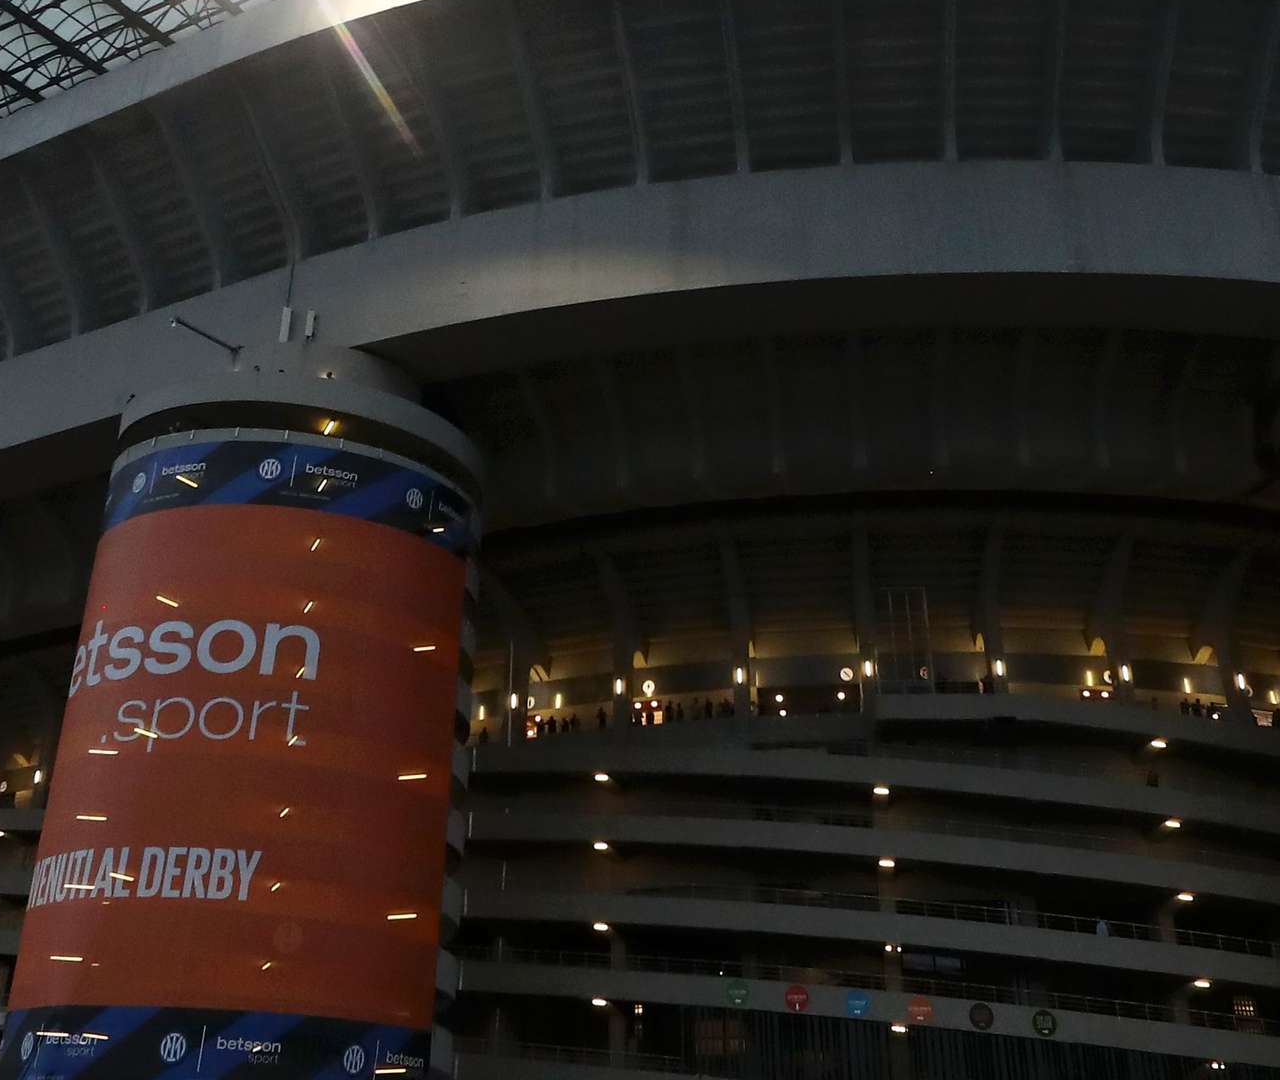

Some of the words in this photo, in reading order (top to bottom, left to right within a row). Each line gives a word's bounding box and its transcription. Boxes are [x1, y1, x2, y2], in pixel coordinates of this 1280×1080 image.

[162, 462, 207, 476] betsson
[304, 463, 358, 481] betsson
[91, 846, 131, 899] AL
[136, 845, 263, 902] DERBY
[216, 1035, 281, 1053] betsson
